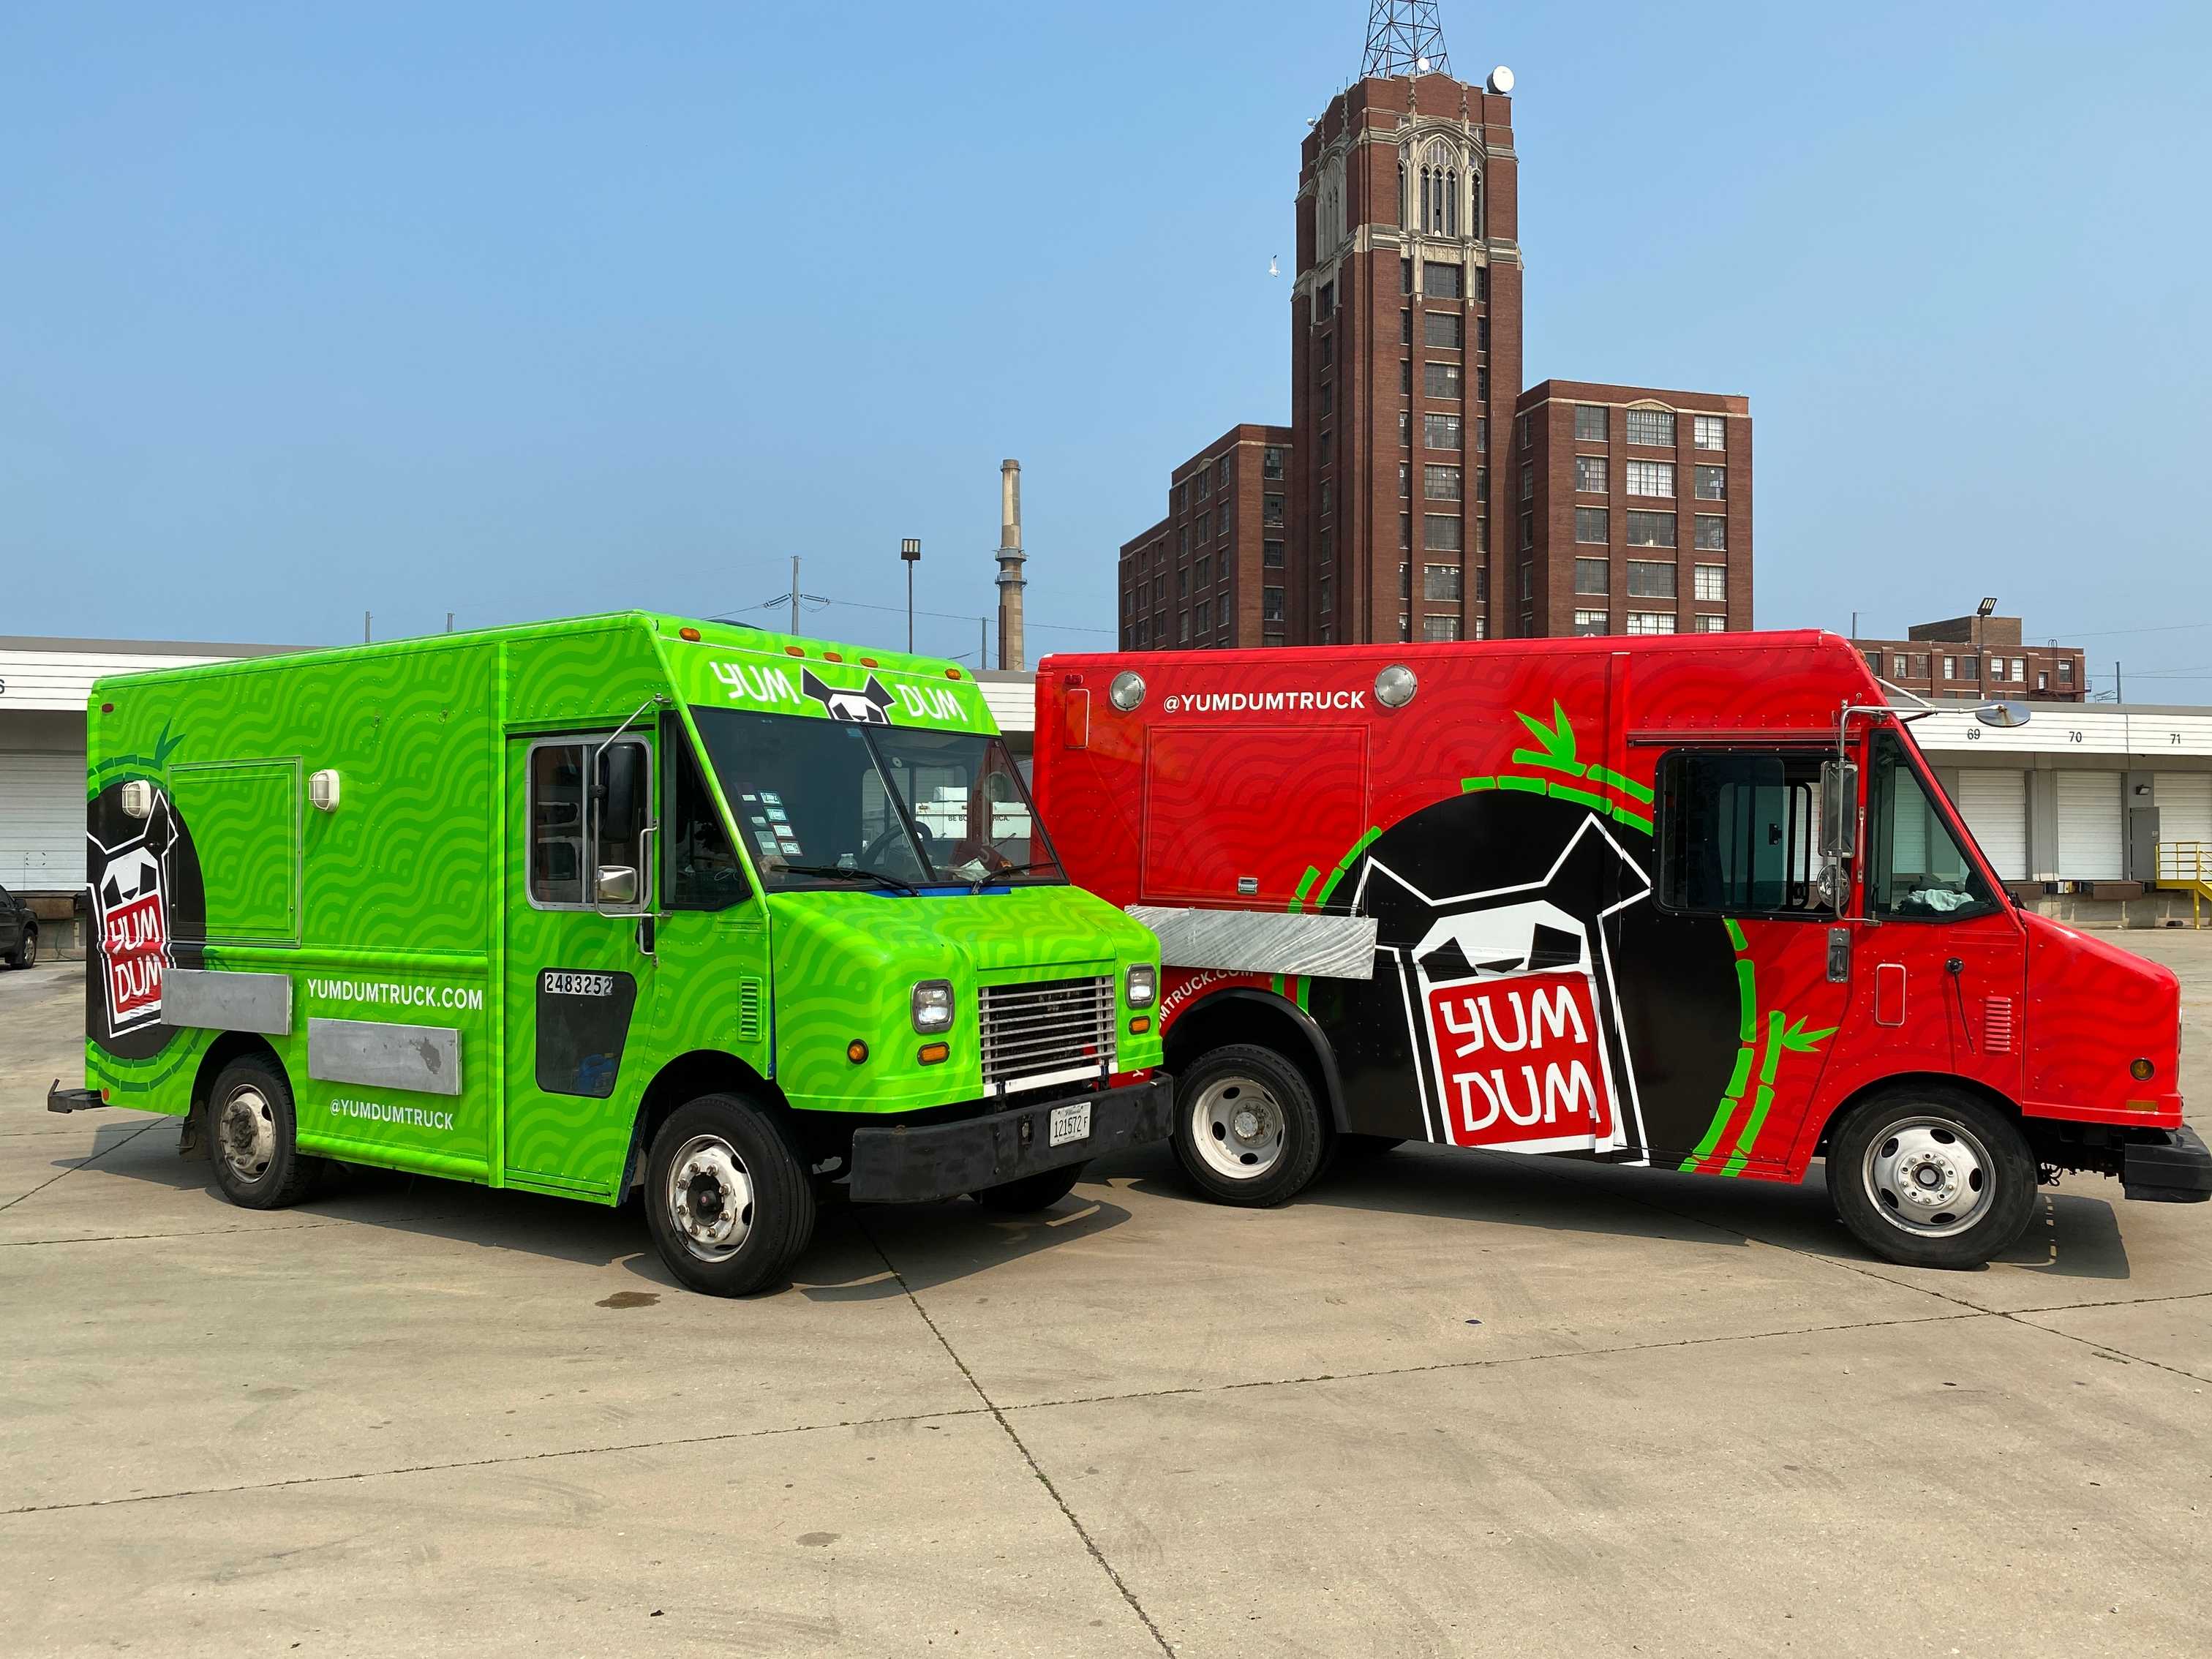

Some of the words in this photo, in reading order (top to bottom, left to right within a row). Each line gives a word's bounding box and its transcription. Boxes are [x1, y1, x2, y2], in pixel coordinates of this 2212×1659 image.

[709, 662, 801, 704] YUM
[895, 684, 968, 722] DUM
[1163, 691, 1366, 713] @YUMDUMTRUCK
[1967, 729, 1981, 740] 69
[2069, 731, 2083, 742] 70
[2170, 734, 2181, 745] 71
[110, 906, 160, 955] YUM
[115, 952, 162, 1004] DUM
[546, 974, 614, 996] 2483252
[307, 979, 483, 1010] YUMDUMTRUCK.COM
[1440, 985, 1589, 1058] YUM
[1452, 1060, 1601, 1132] DUM
[331, 1099, 454, 1130] @YUMDUMTRUCK
[1054, 1115, 1082, 1138] 121572
[1083, 1116, 1088, 1129] F
